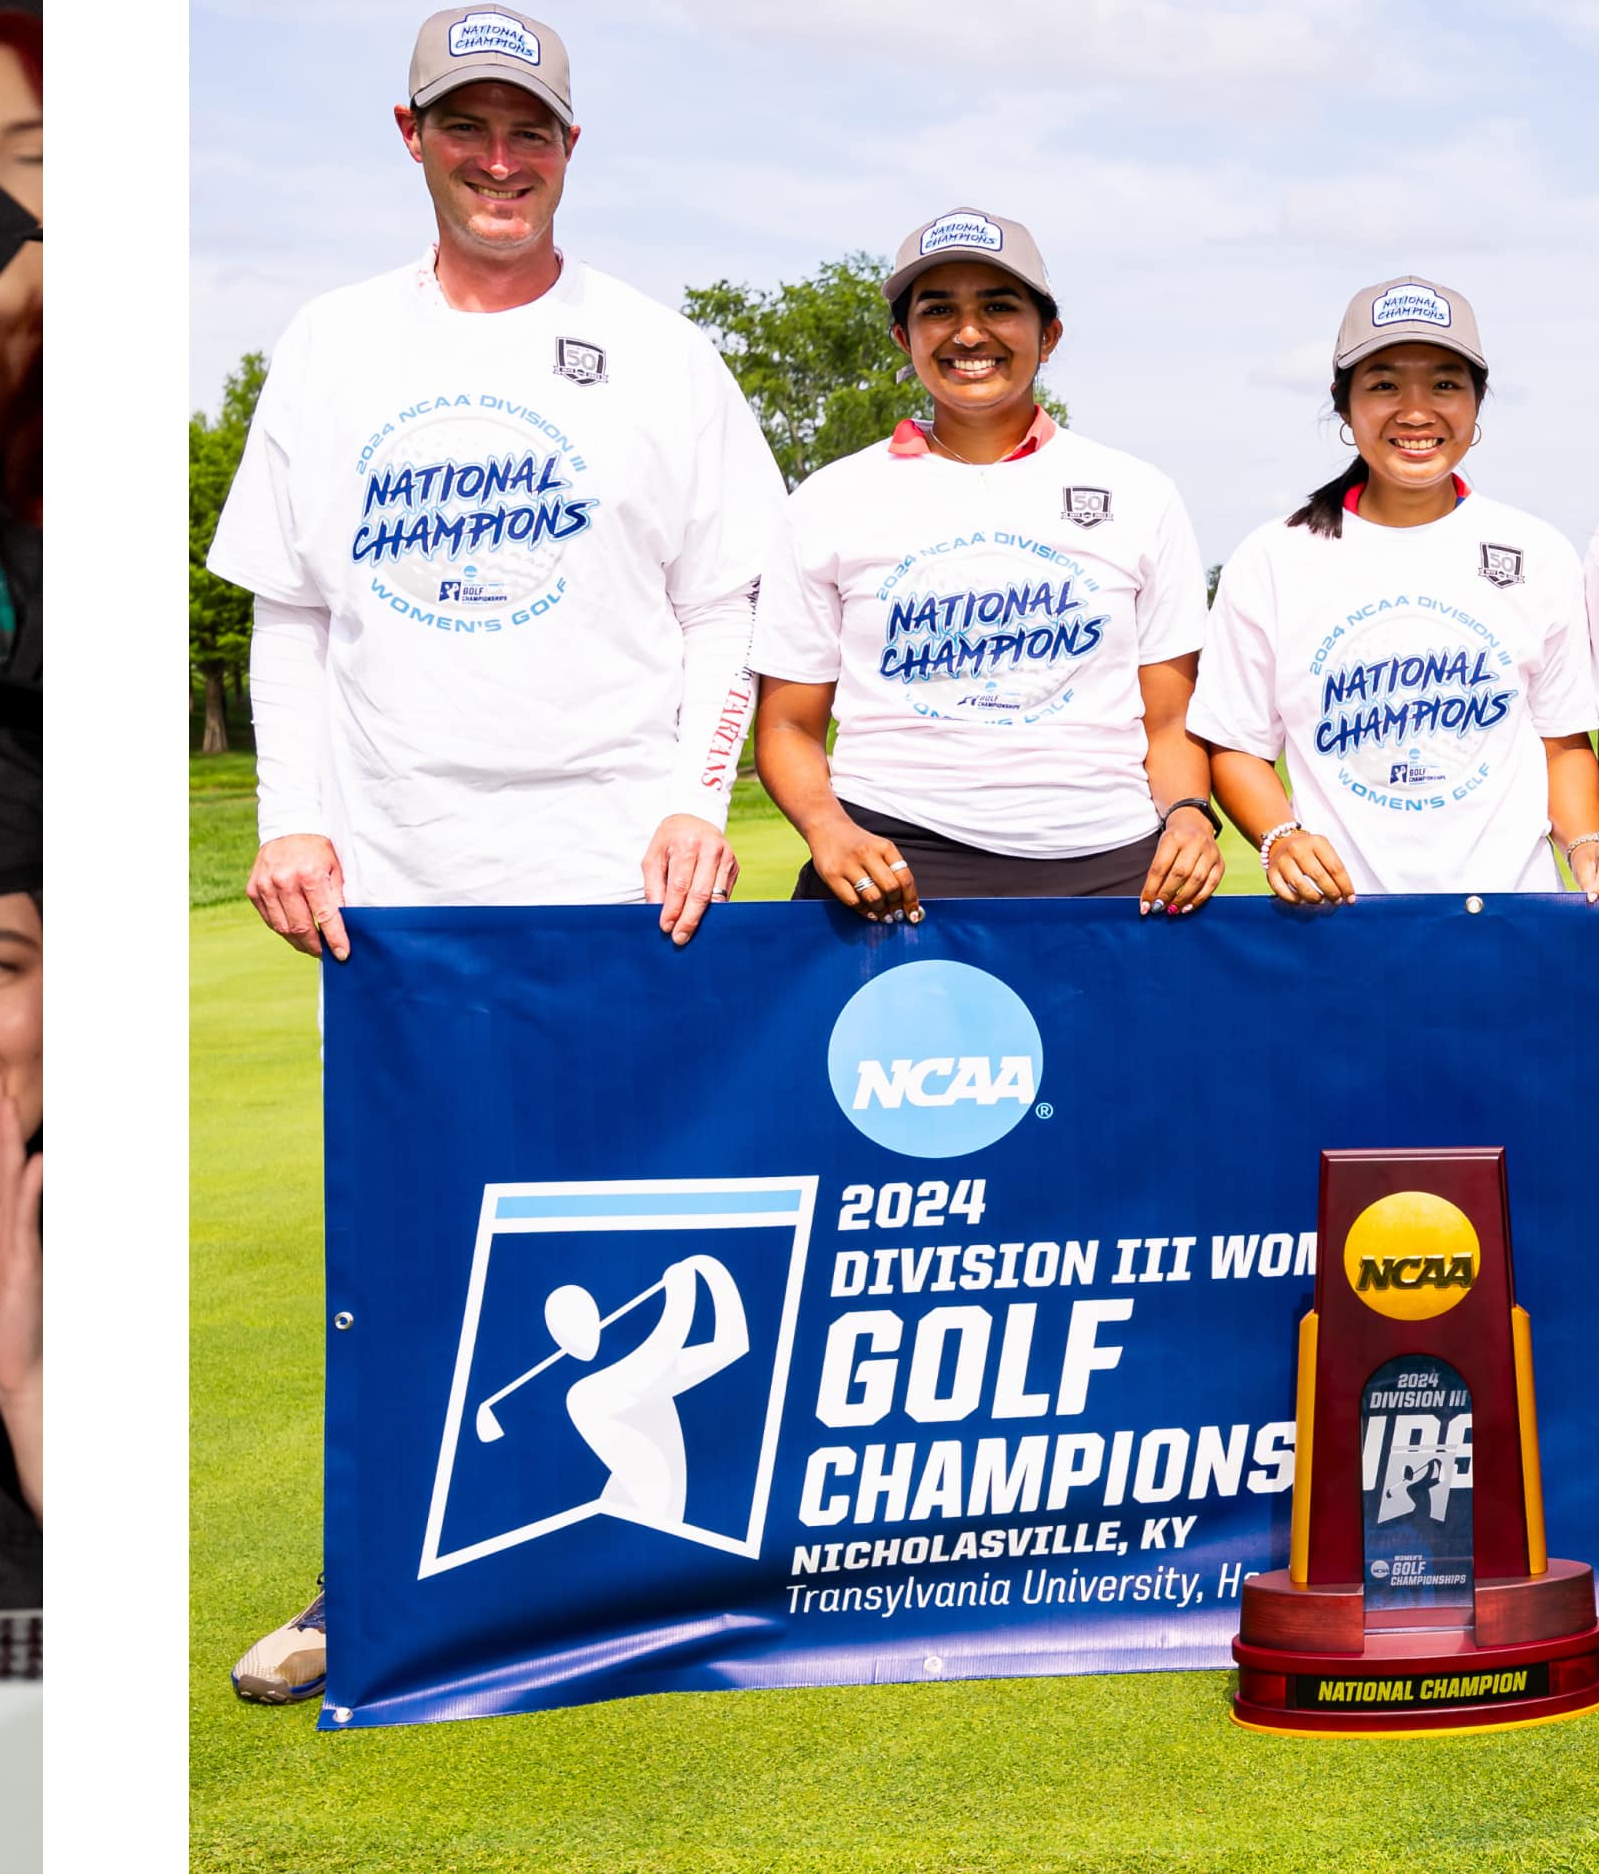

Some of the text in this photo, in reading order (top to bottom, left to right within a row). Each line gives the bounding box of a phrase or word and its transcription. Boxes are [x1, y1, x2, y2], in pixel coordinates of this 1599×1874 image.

[455, 36, 534, 57] CHAMPIONS
[461, 24, 526, 44] NATIONAL
[925, 232, 996, 248] CHAMPIONS
[931, 223, 986, 238] NATIONAL
[1377, 307, 1446, 320] CHAMPIONS
[1382, 295, 1437, 309] NATIONAL
[567, 349, 596, 371] 50
[356, 394, 588, 475] 2024 NCAA DIVISION III
[362, 454, 570, 518] NATIONAL
[1073, 495, 1102, 511] 50
[351, 498, 598, 562] CHAMPIONS
[876, 531, 1101, 602] 2024 NCAA DIVISION III
[1490, 553, 1515, 573] 50
[370, 577, 568, 634] WOMEN'S GOLF
[888, 580, 1083, 641] NATIONAL
[878, 617, 1106, 678] CHAMPIONS
[1310, 595, 1513, 676] 2024 NCAA DIVISION III
[1323, 650, 1496, 715] NATIONAL
[701, 688, 752, 792] TARTANS
[1315, 690, 1517, 754] CHAMPIONS
[1338, 762, 1491, 812] WOMEN'S GOLF
[852, 1055, 1037, 1110] NCAA
[838, 1179, 987, 1231] 2024
[829, 1239, 1099, 1298] DIVISION
[1111, 1236, 1197, 1284] III
[1355, 1253, 1474, 1292] NCAA
[815, 1298, 1135, 1428] GOLF
[1397, 1373, 1439, 1388] 2024
[1370, 1390, 1468, 1408] DIVISION III
[791, 1515, 1198, 1575] NICHOLASVILLE, KY
[1392, 1560, 1427, 1576] GOLF
[786, 1562, 1259, 1618] Transylvania University, H
[1390, 1574, 1466, 1586] CHAMPIONSHIPS
[1318, 1670, 1528, 1703] NATIONAL CHAMPION
